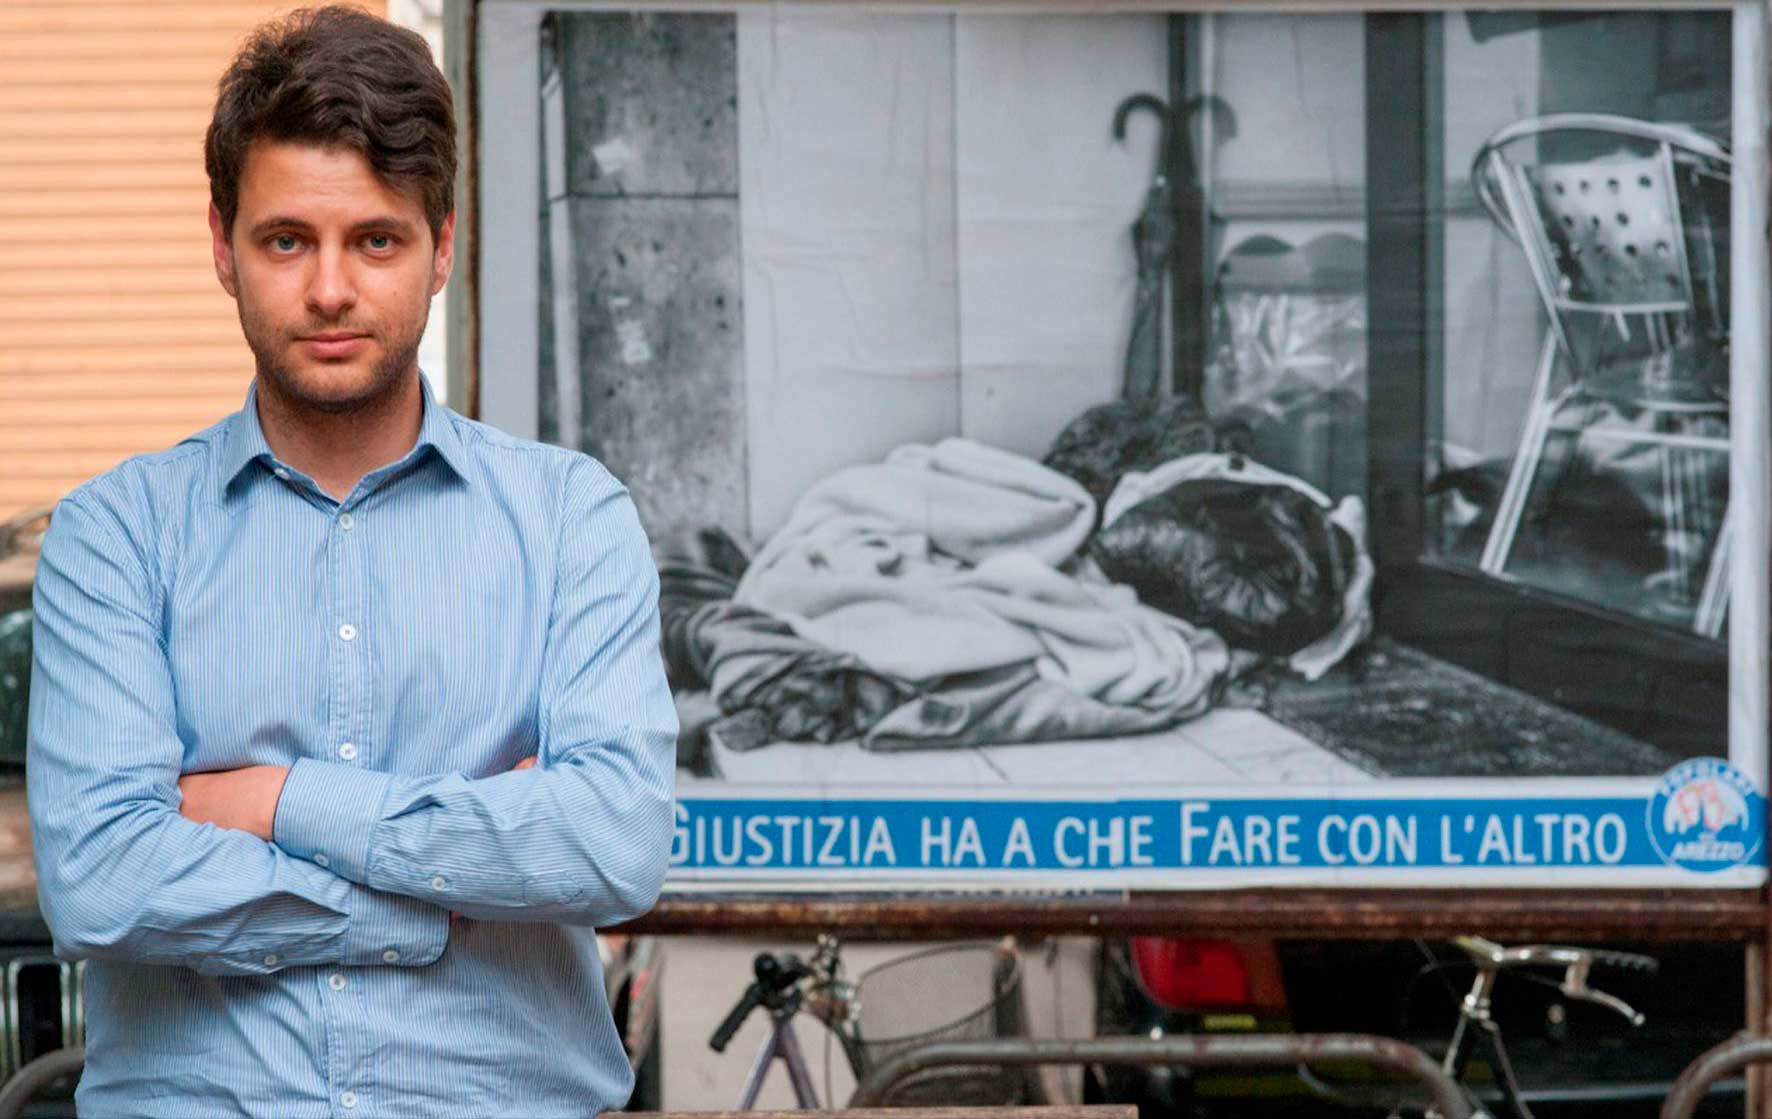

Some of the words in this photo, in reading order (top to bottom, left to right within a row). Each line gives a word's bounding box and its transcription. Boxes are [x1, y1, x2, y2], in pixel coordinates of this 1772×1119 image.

[920, 816, 986, 866] HA
[1002, 816, 1037, 866] A
[1053, 815, 1154, 866] CHE
[1180, 801, 1300, 865] FARE
[1317, 814, 1418, 864] CON
[1440, 813, 1627, 864] L'ALTRO
